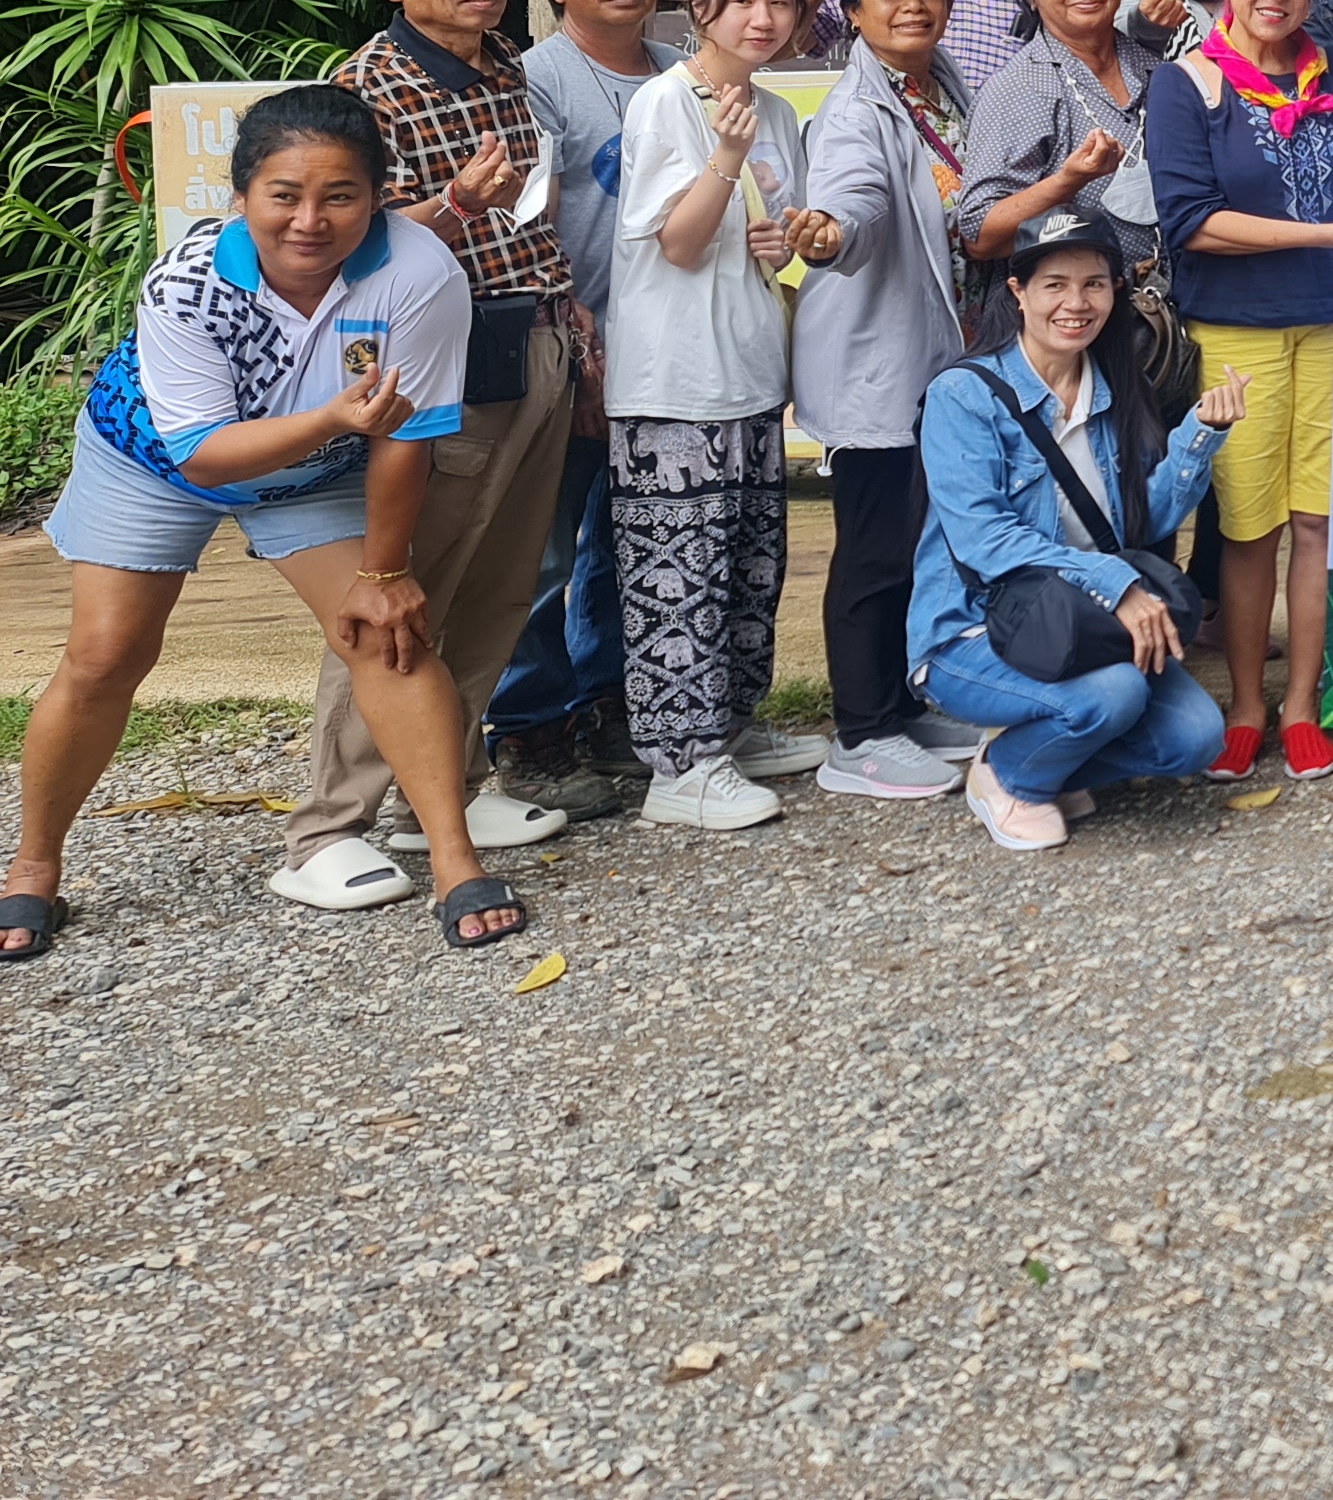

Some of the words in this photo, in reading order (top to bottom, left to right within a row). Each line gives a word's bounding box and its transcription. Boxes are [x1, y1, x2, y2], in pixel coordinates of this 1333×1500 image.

[181, 102, 236, 156] โป
[185, 164, 234, 210] สิ่ง
[1045, 214, 1079, 233] NIKE
